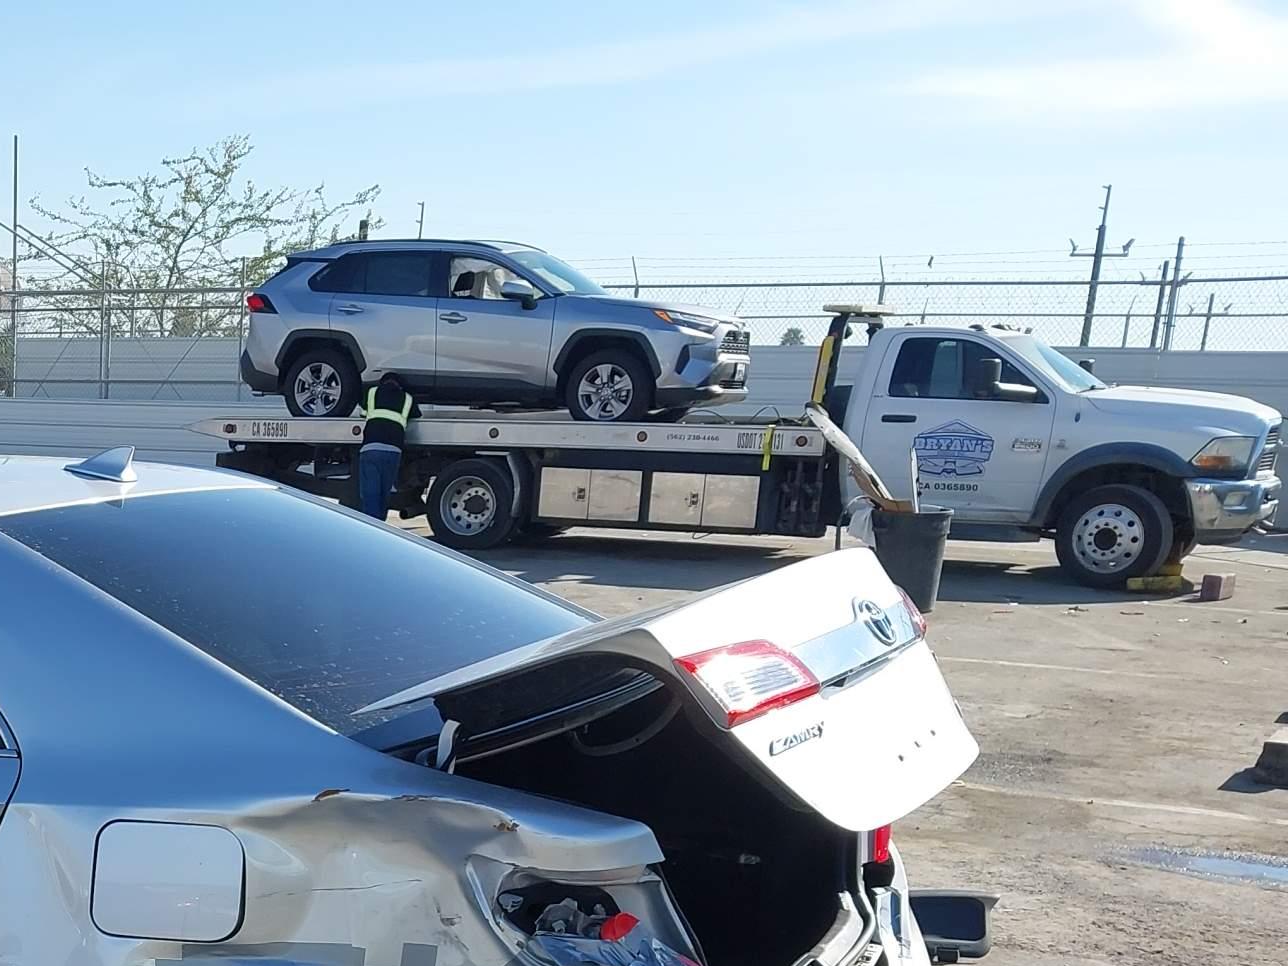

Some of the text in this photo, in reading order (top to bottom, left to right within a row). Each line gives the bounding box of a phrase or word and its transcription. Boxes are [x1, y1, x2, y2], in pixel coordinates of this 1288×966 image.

[252, 421, 288, 438] CA 365890
[934, 482, 979, 491] 0365890
[768, 720, 825, 757] CAMRY
